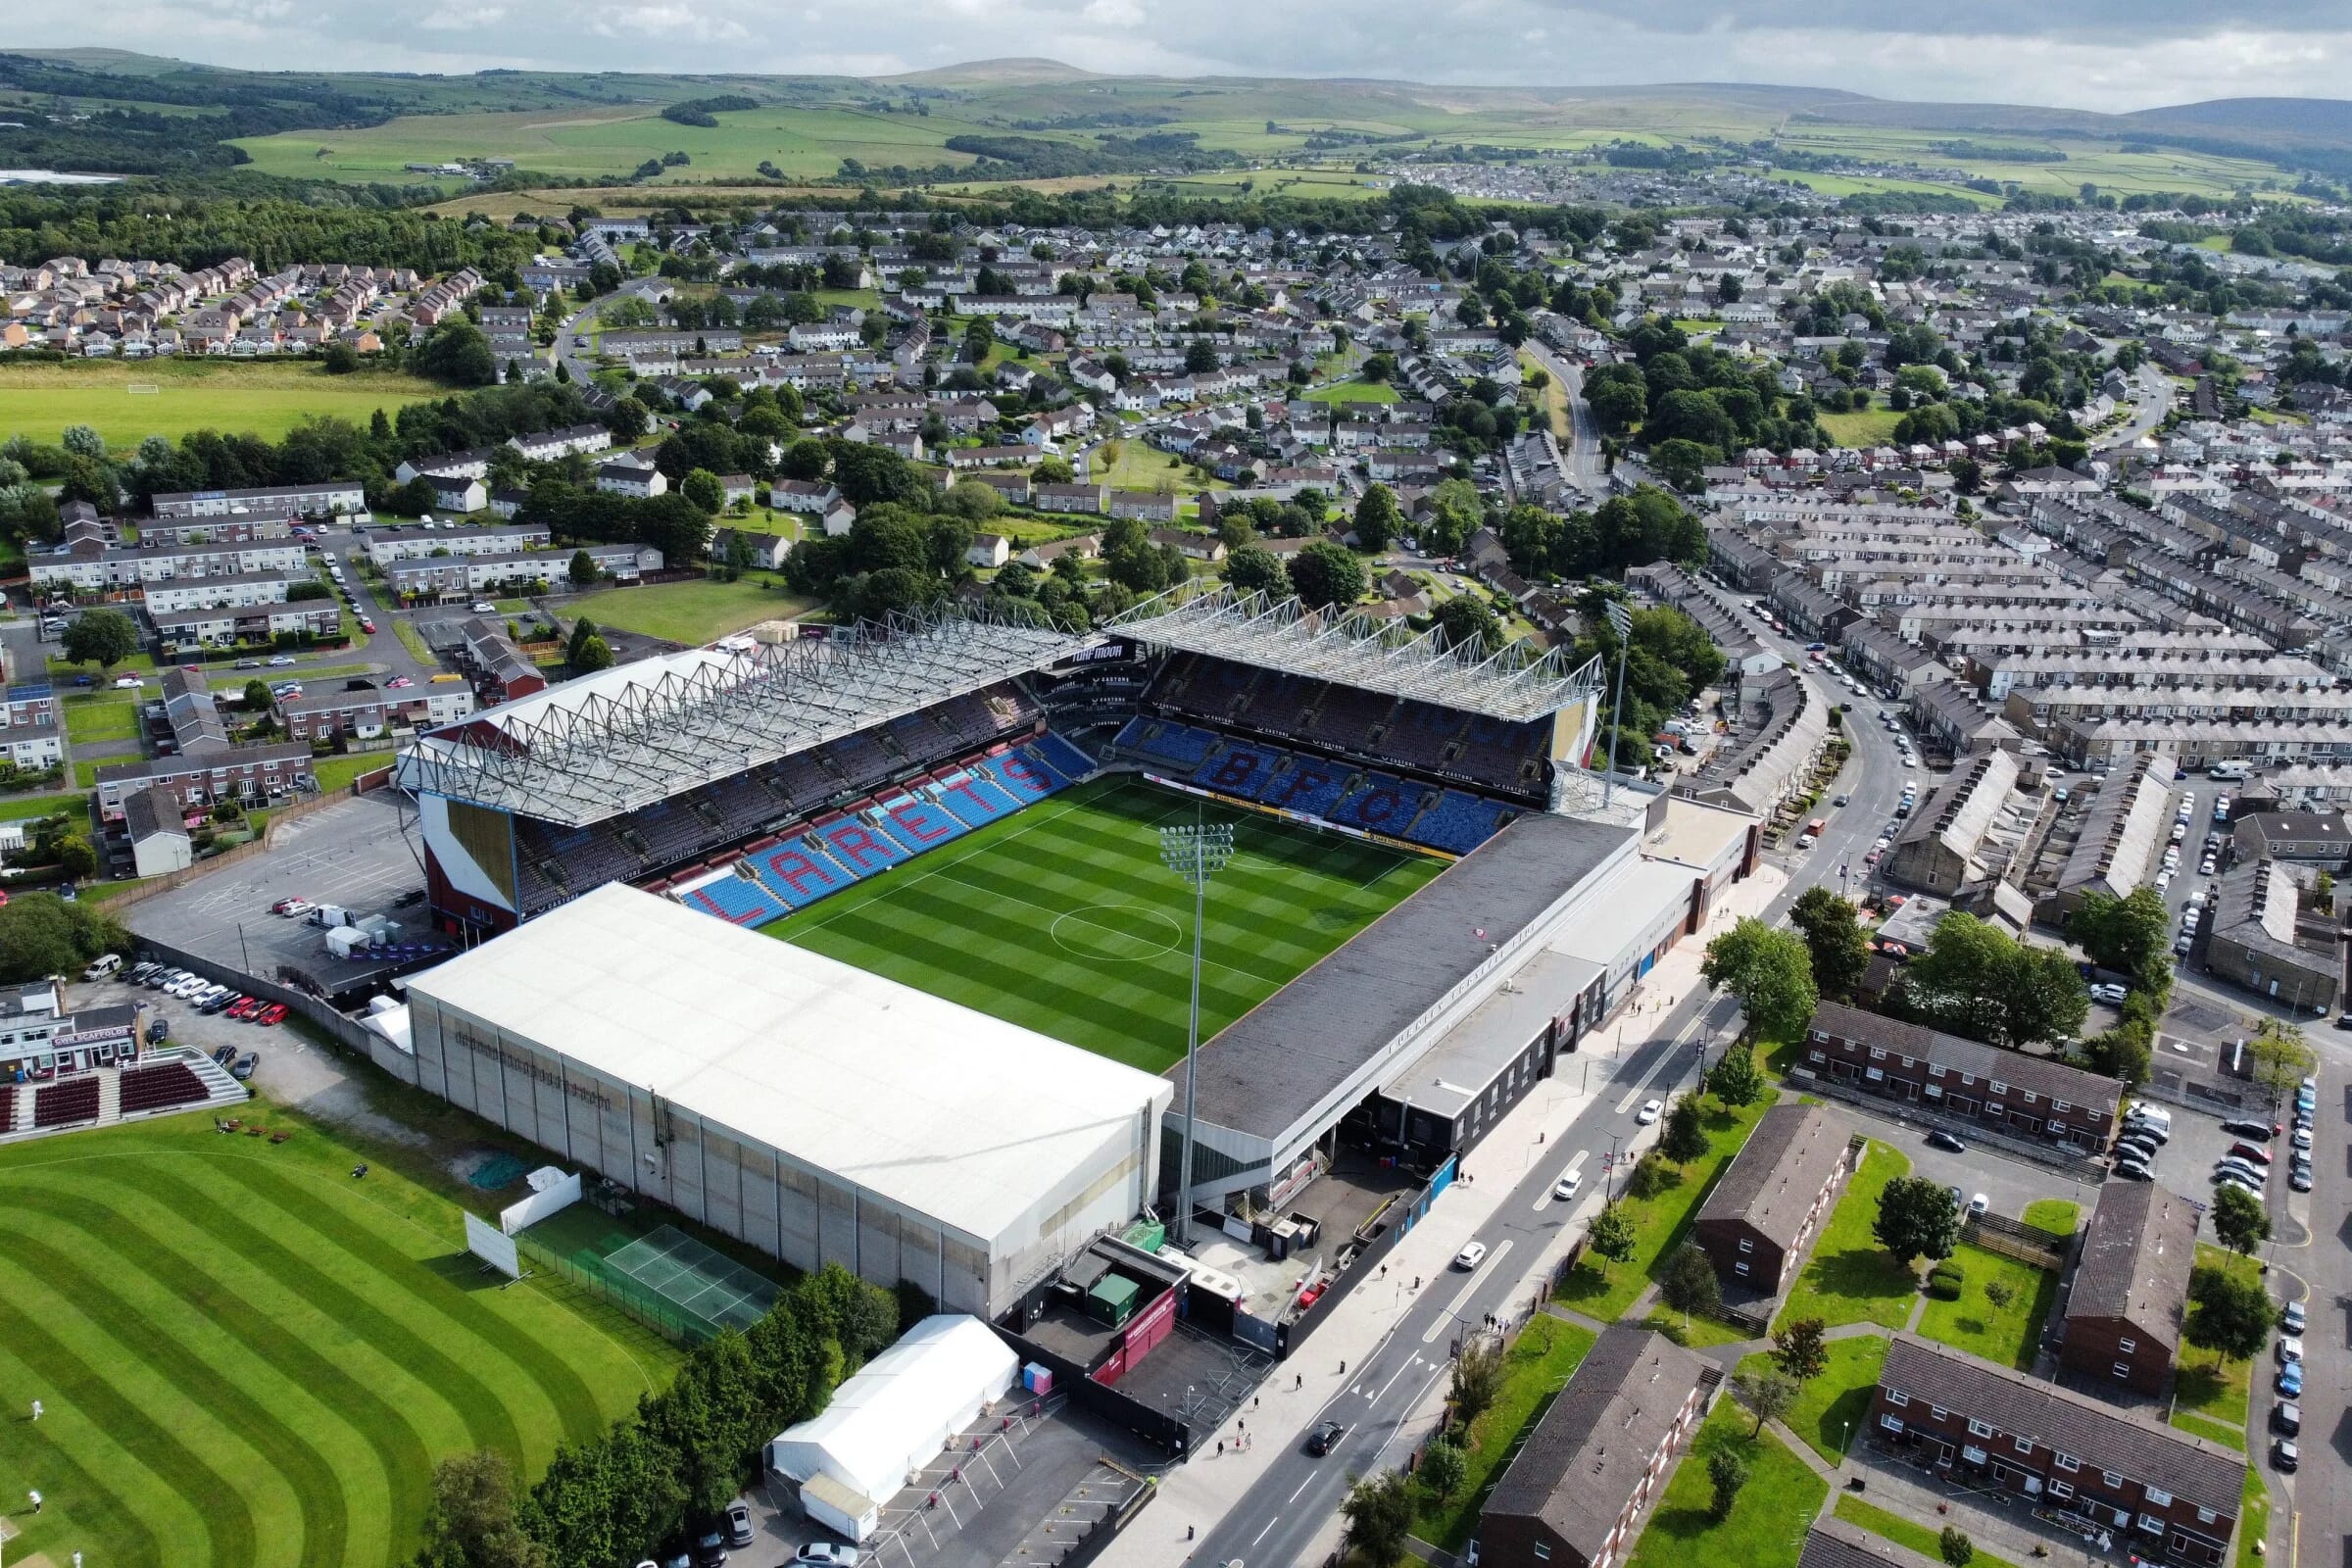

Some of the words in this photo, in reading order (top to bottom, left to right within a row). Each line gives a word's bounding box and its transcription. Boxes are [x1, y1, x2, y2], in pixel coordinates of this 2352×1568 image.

[1073, 647, 1096, 662] TURF
[1095, 645, 1123, 659] MOOR
[1390, 758, 1416, 768] CASTORE
[1446, 770, 1473, 782] CASTORE
[1502, 785, 1530, 796] CASTORE
[727, 826, 754, 841] CASTORE
[671, 847, 699, 861] CASTORE
[548, 893, 580, 909] CASTORE
[77, 1027, 128, 1042] SCAFFOLDS
